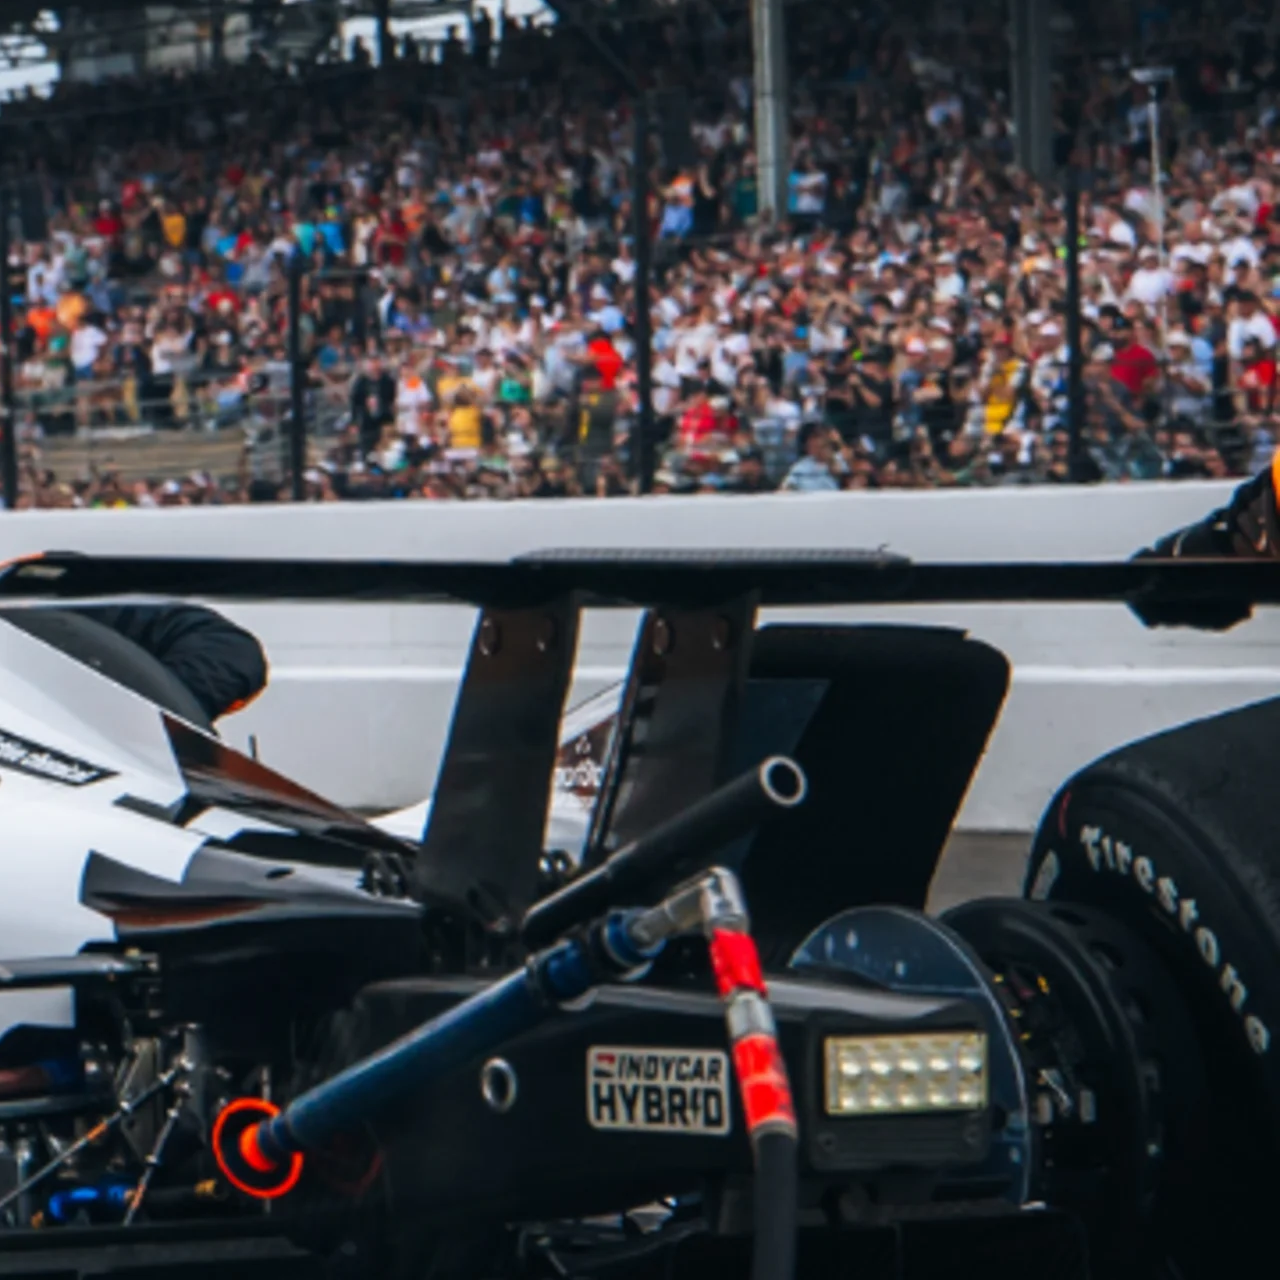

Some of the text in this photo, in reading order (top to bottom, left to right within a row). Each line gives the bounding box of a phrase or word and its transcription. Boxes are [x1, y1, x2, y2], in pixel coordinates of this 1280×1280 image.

[1080, 824, 1270, 1054] Firestone
[618, 1054, 723, 1081] INDYCAR
[593, 1083, 724, 1128] HYBRID
